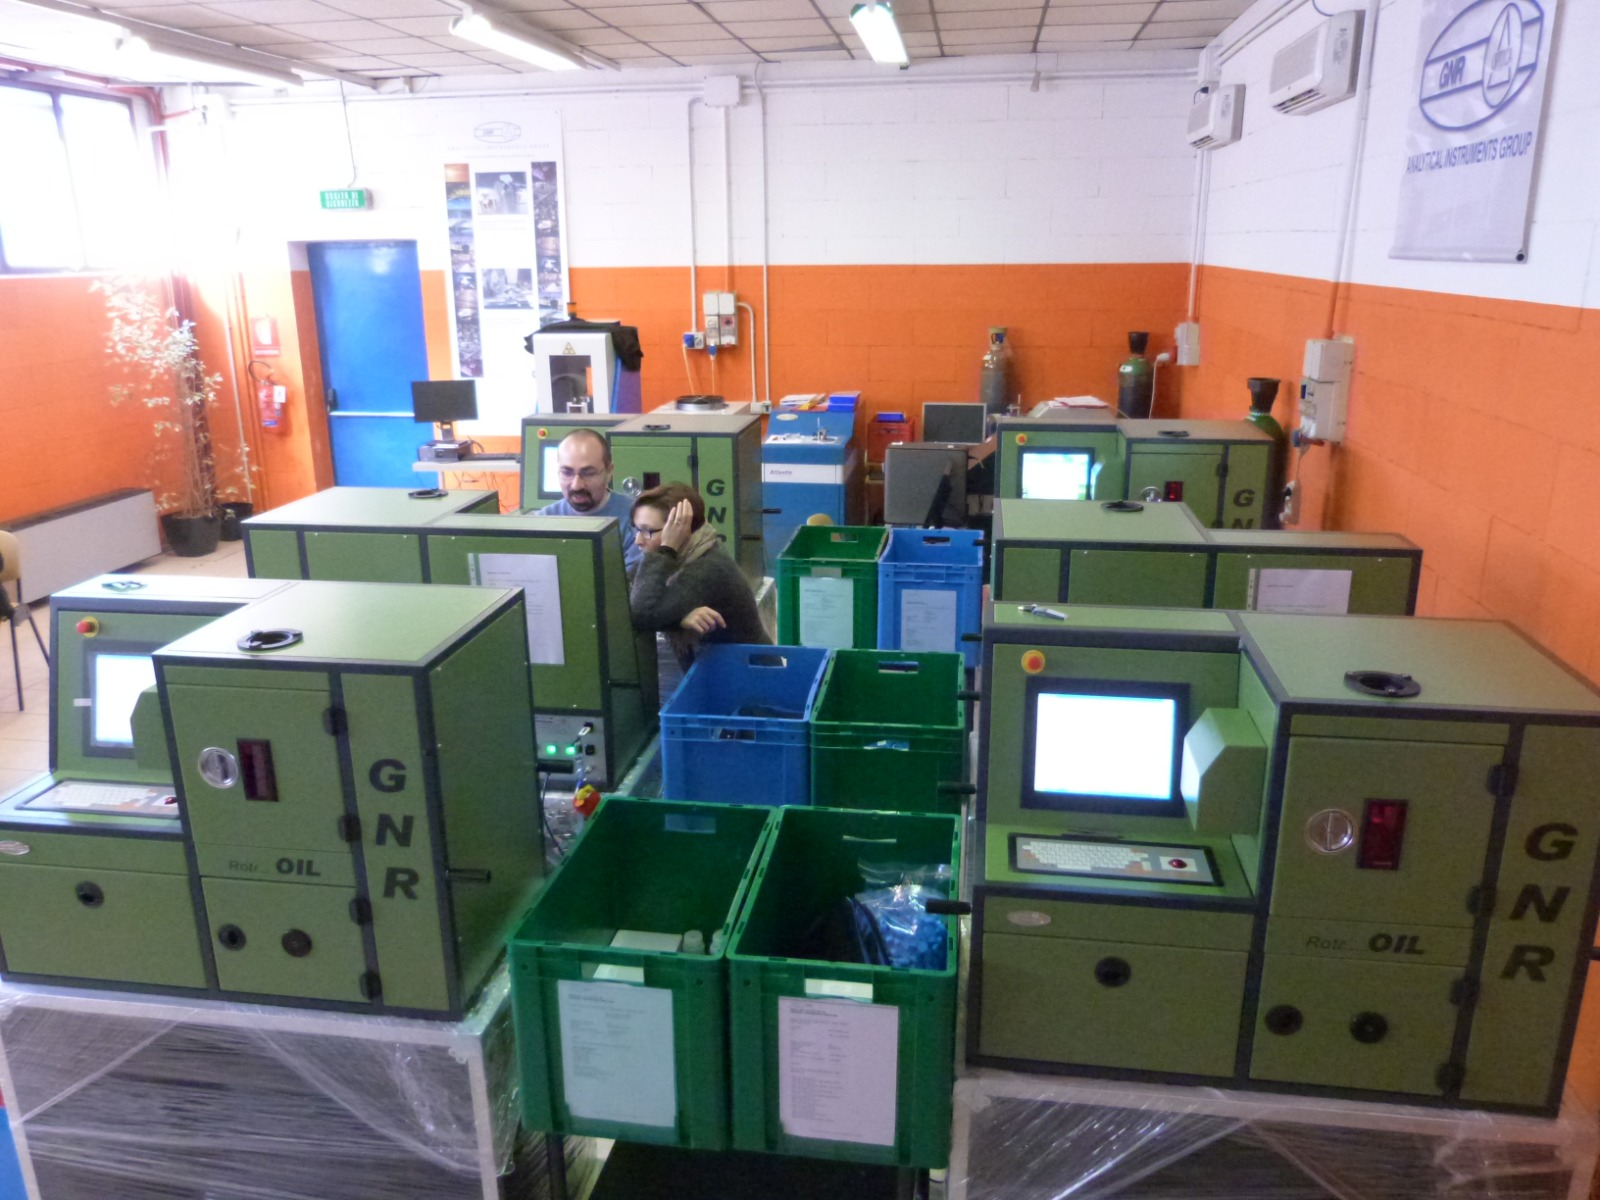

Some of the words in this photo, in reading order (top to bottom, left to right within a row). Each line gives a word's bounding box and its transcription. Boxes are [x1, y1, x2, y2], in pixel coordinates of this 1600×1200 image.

[1439, 55, 1466, 89] GNR
[1406, 150, 1442, 174] ANALYTICAL
[1444, 138, 1498, 169] INSTRUMENTS
[1500, 131, 1533, 159] GROUP
[276, 857, 321, 877] OIL
[1368, 932, 1424, 954] OIL
